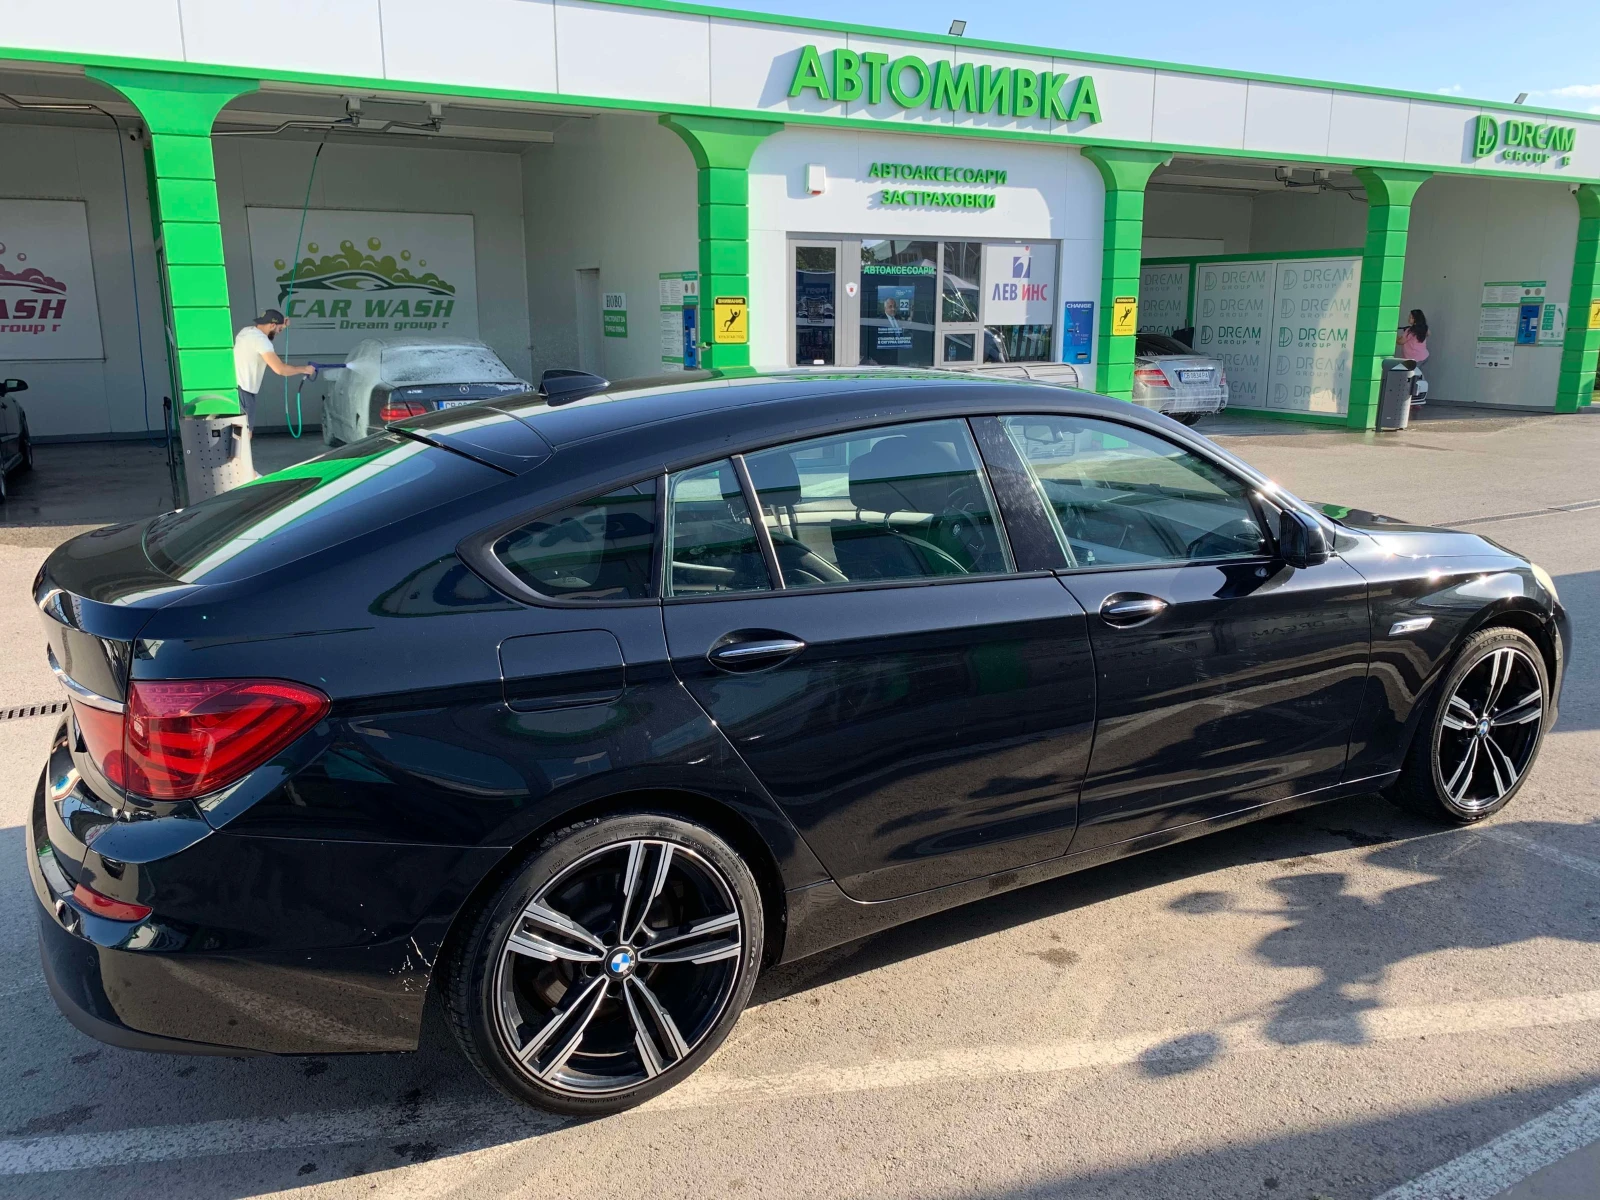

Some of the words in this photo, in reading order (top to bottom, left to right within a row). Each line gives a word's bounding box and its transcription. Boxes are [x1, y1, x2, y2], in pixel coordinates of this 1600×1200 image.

[787, 45, 1102, 124] АВТОМИВКА
[1504, 119, 1577, 151] DREAM
[1503, 149, 1550, 163] GROUP
[1561, 156, 1571, 167] R
[868, 162, 1008, 184] АВТОАКСЕСОАРИ
[881, 189, 997, 209] ЗАСТРАХОВКИ
[863, 265, 935, 275] АВТОАКСЕСОАРИ
[1222, 270, 1266, 283] DREAM
[1303, 268, 1354, 282] DREAM
[1144, 273, 1183, 285] DREAM
[992, 283, 1018, 301] ЛЕВ
[1021, 283, 1048, 301] ИНС
[0, 299, 67, 319] SH
[288, 299, 352, 318] CAR
[365, 299, 455, 318] WASH
[1143, 299, 1182, 311] DREAM
[1220, 298, 1264, 311] DREAM
[1301, 298, 1351, 312] DREAM
[0, 324, 45, 335] roup
[340, 320, 389, 330] Dream
[393, 321, 438, 331] group
[1218, 326, 1262, 338] DREAM
[1298, 327, 1348, 341] DREAM
[1296, 356, 1345, 371] DREAM
[1479, 634, 1518, 650] NEXEN
